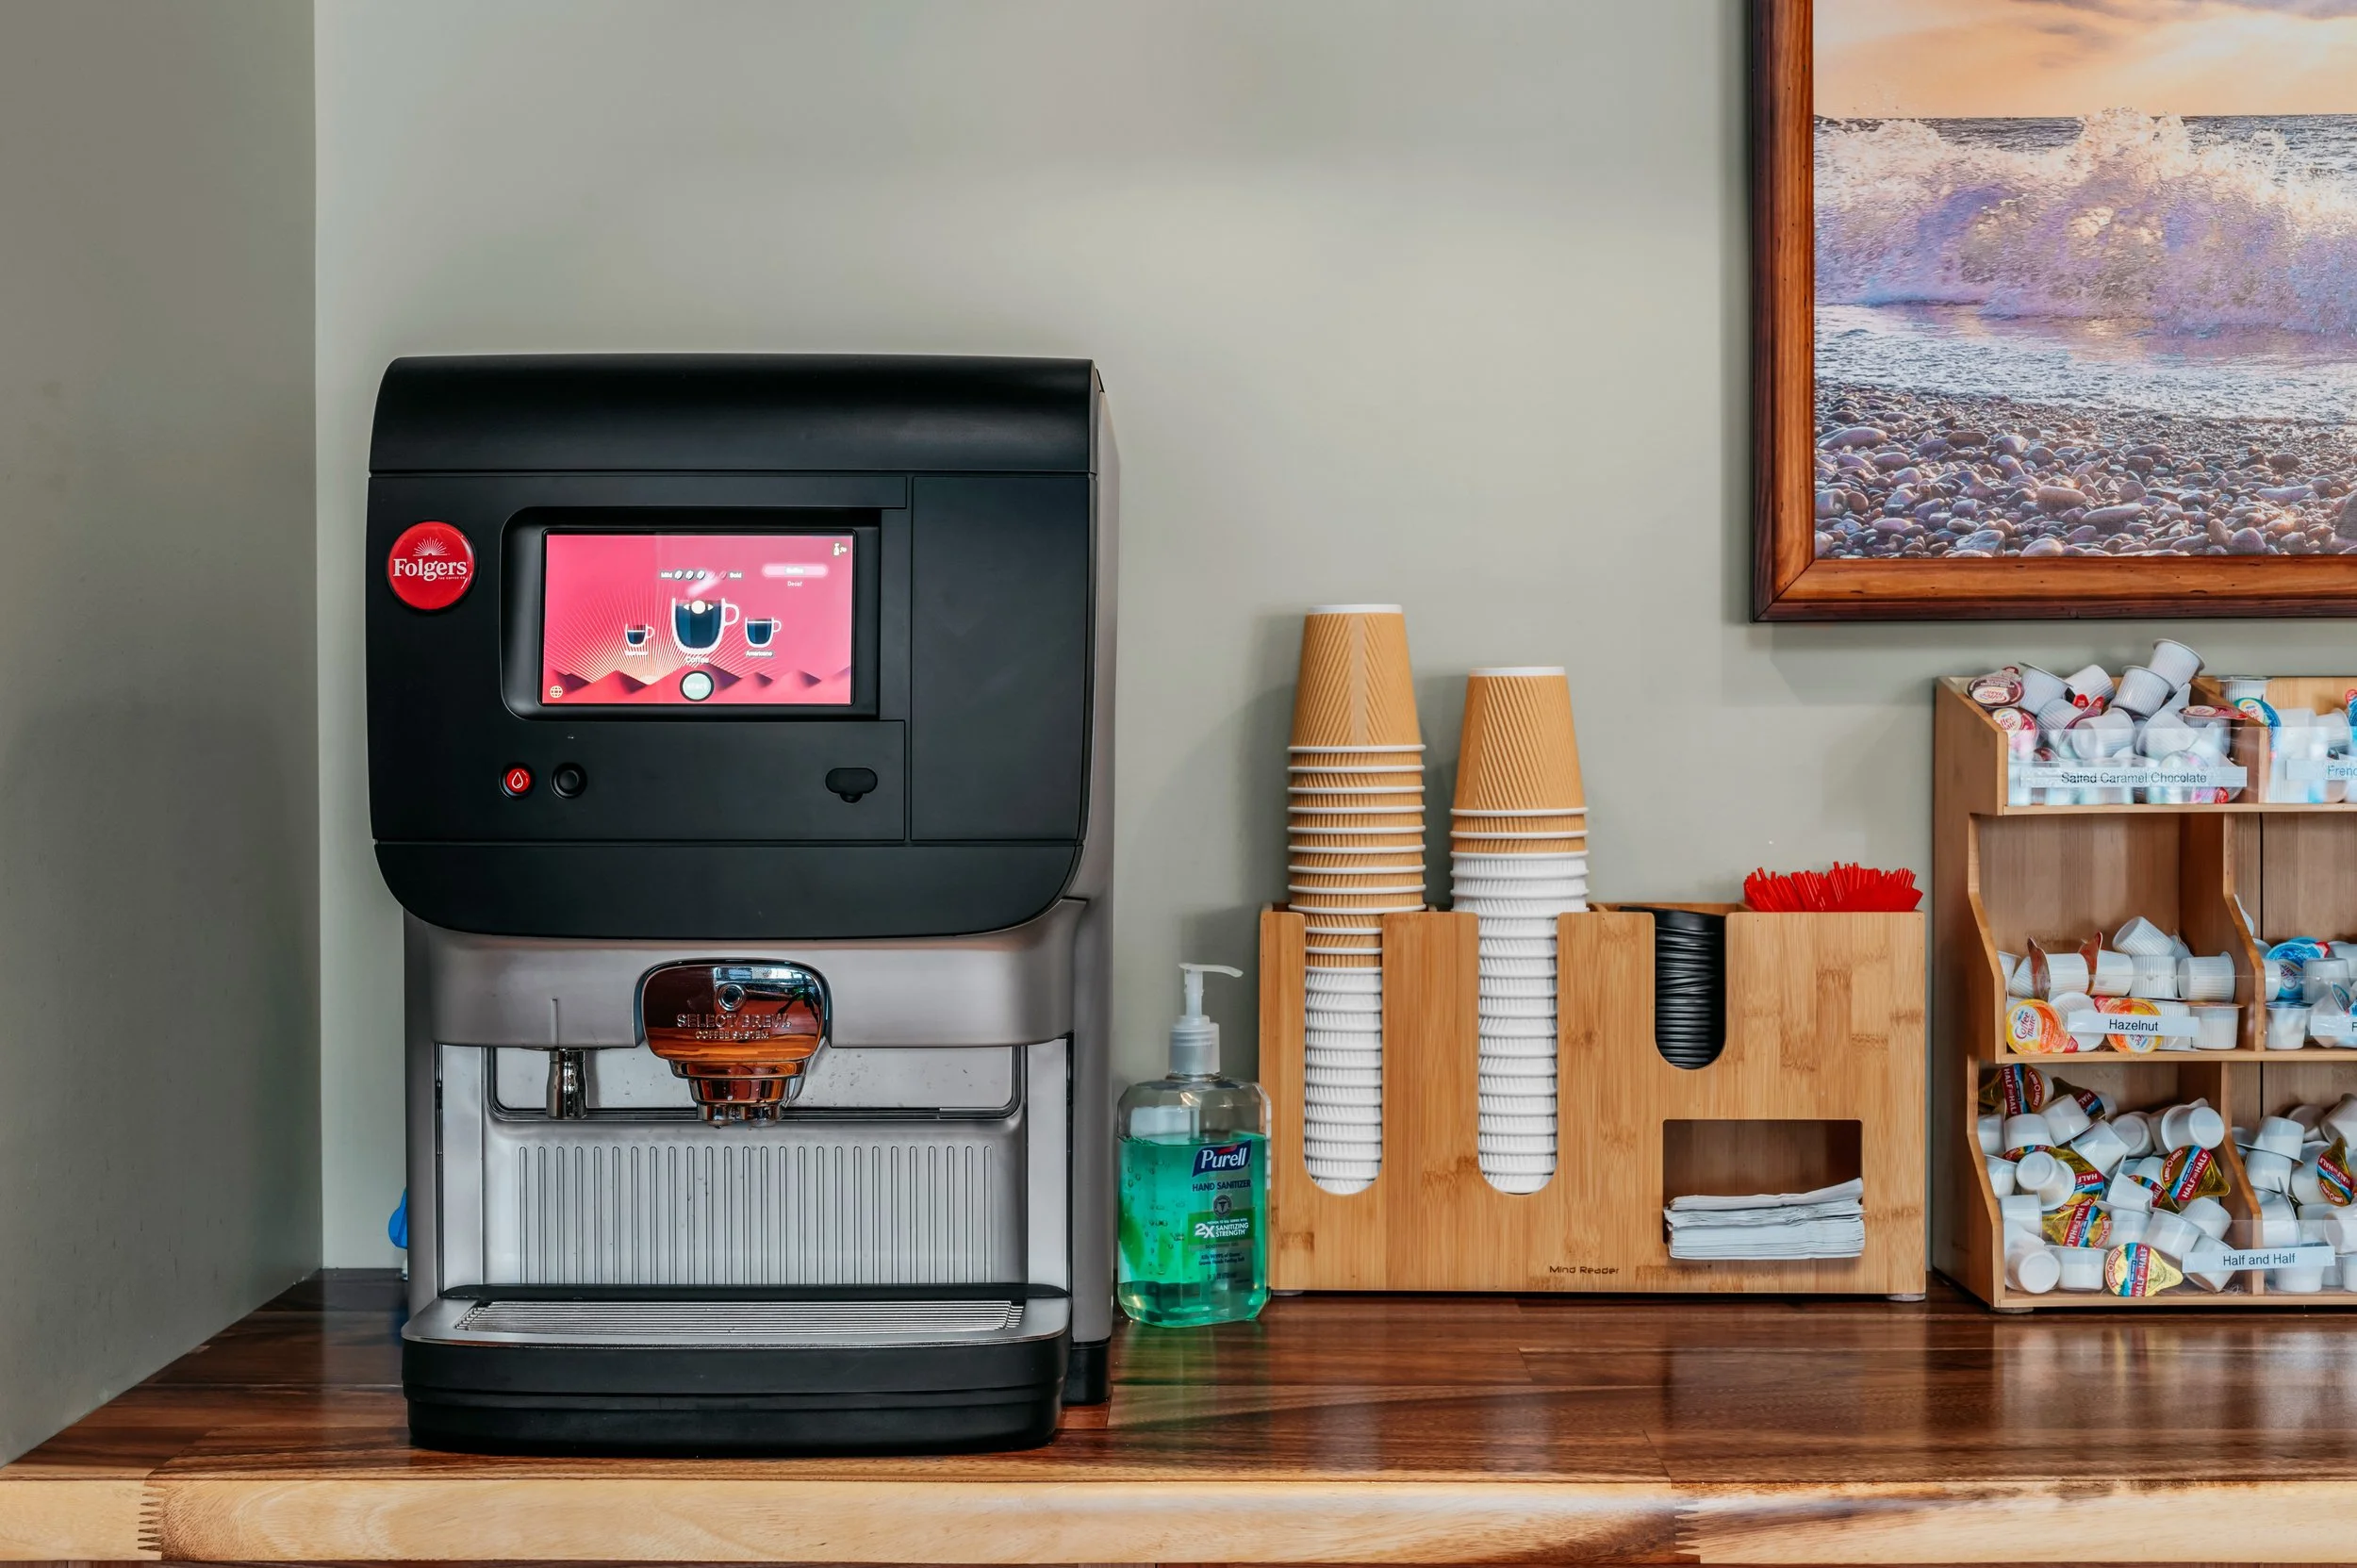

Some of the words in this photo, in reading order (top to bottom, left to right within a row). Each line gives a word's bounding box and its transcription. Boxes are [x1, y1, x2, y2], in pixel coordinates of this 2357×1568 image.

[393, 558, 468, 582] Folgers
[2061, 771, 2098, 784] Salted
[2100, 771, 2148, 784] Caramel
[2151, 771, 2207, 784] Chocolate
[677, 1013, 737, 1029] SELECT
[741, 1013, 789, 1028] BREW
[2015, 1011, 2031, 1040] Coffee
[2027, 1014, 2036, 1038] mate
[2109, 1018, 2159, 1032] Hazelnut
[695, 1030, 730, 1040] COFFEE
[732, 1030, 770, 1040] SYSTEM
[2003, 1067, 2014, 1088] HALF
[2077, 1092, 2092, 1105] HAL
[1200, 1147, 1247, 1169] Purell
[2319, 1157, 2333, 1171] HALF
[2077, 1173, 2098, 1184] HALF
[2182, 1178, 2196, 1198] HALF
[2197, 1152, 2209, 1173] HALF
[1192, 1182, 1215, 1193] HAND
[1216, 1179, 1251, 1190] SANITIZER
[2074, 1207, 2085, 1224] HALF
[1195, 1222, 1215, 1239] 2X
[1215, 1222, 1249, 1232] SANITIZING
[1215, 1229, 1245, 1238] STRENGTH
[2138, 1246, 2148, 1269] HALF
[2222, 1254, 2246, 1266] Half
[2249, 1254, 2269, 1265] and
[2273, 1252, 2296, 1264] Half
[1549, 1265, 1576, 1274] Mind
[1579, 1265, 1620, 1275] Reader
[2134, 1275, 2145, 1296] HALF
